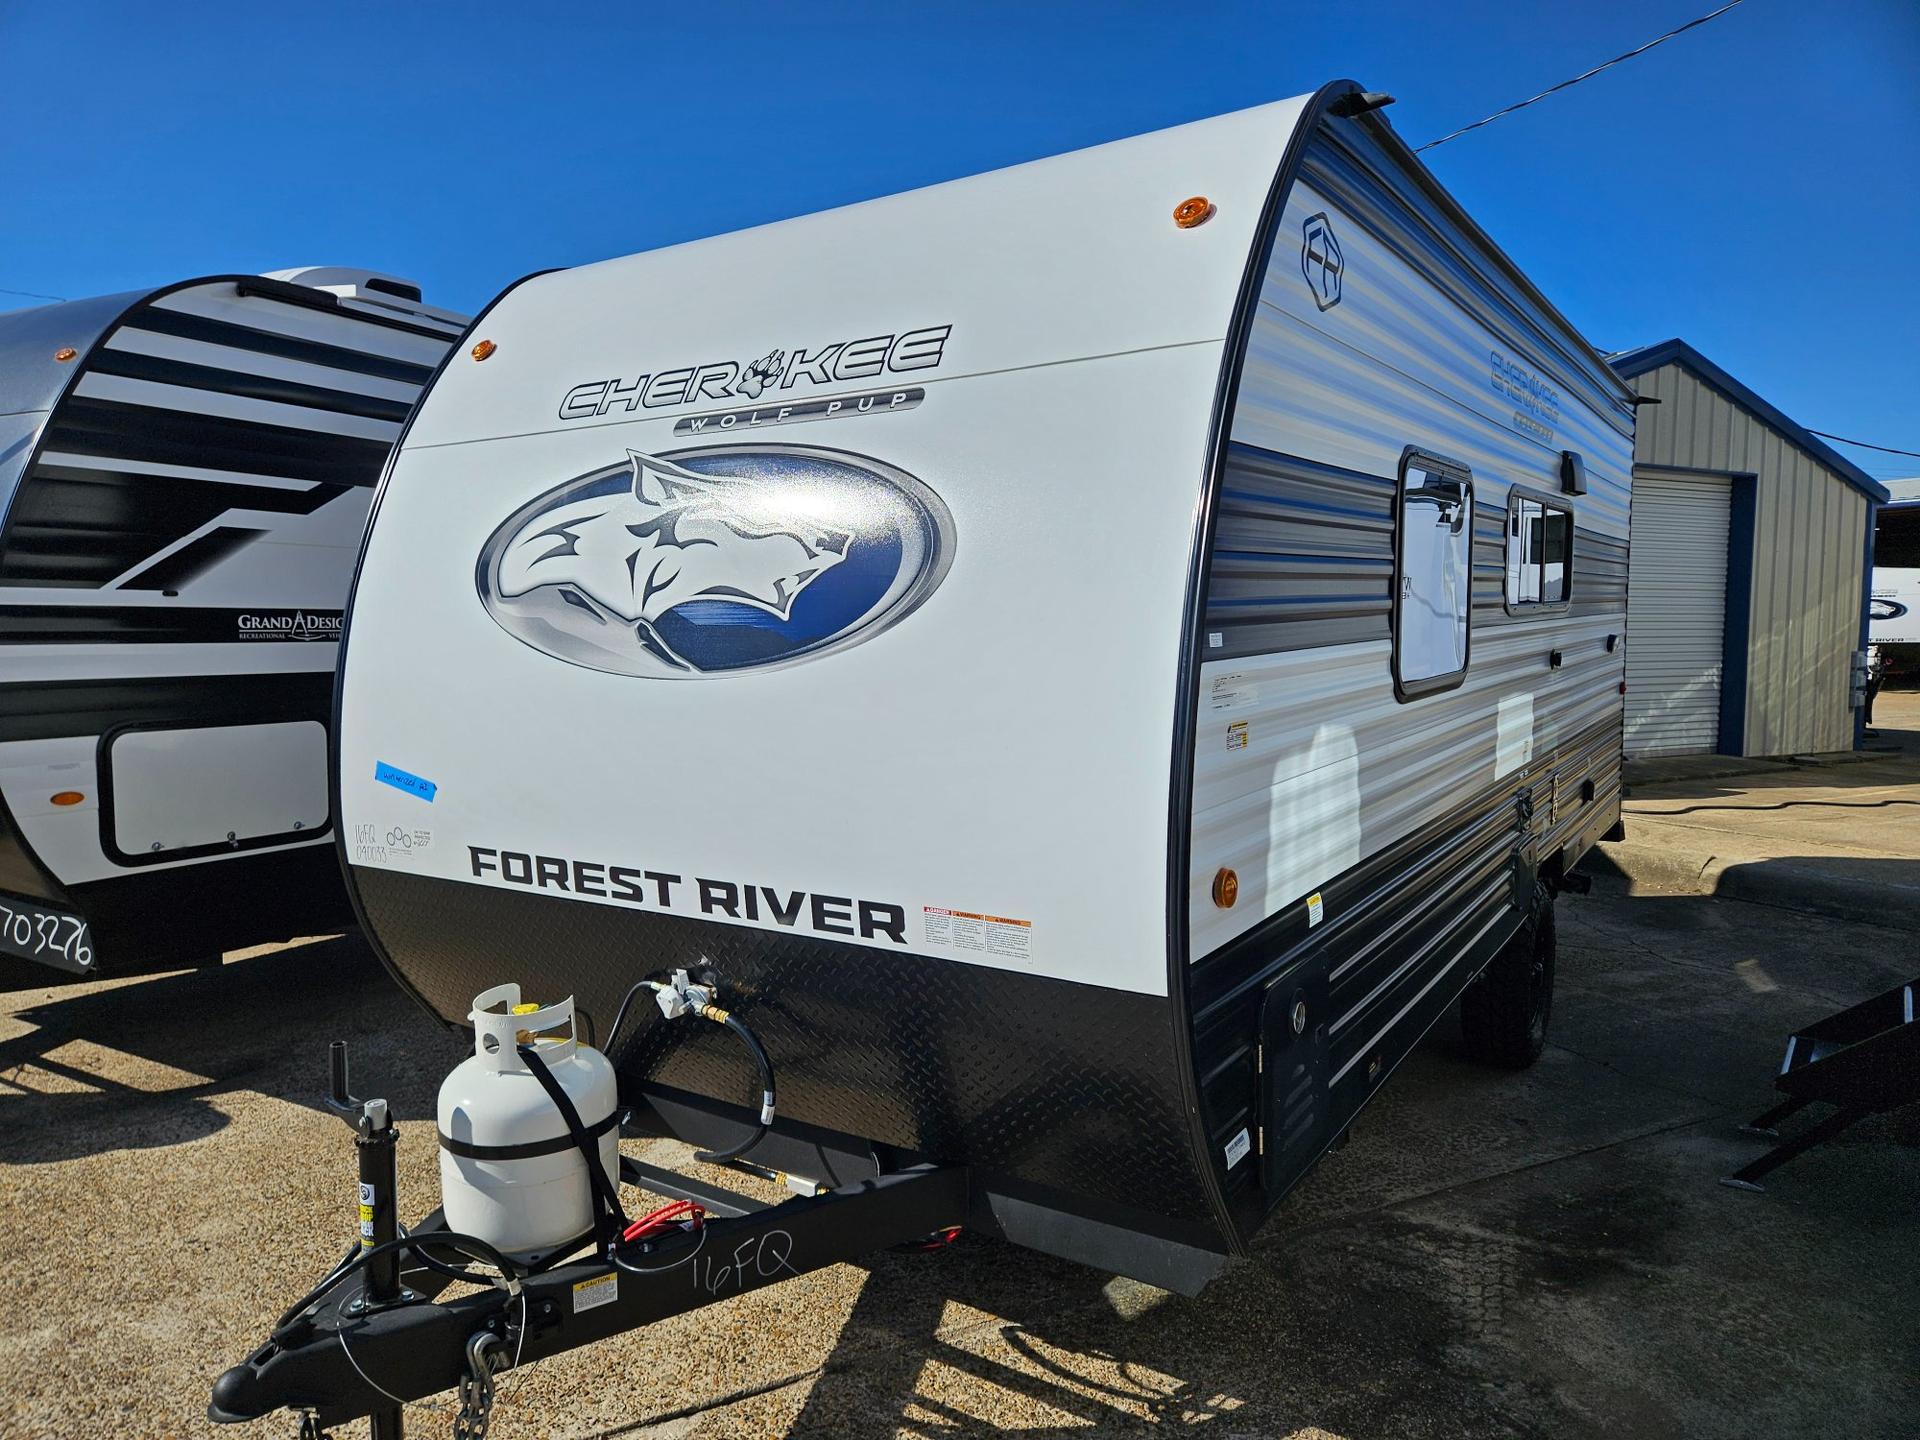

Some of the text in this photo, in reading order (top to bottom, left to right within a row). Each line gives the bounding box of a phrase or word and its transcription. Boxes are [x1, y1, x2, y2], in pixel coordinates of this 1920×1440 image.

[689, 392, 909, 432] WOLF PUP
[238, 614, 344, 629] GRAND DESIG
[467, 845, 682, 908] FOREST
[694, 877, 909, 944] RIVER
[693, 1229, 801, 1296] 16FQ
